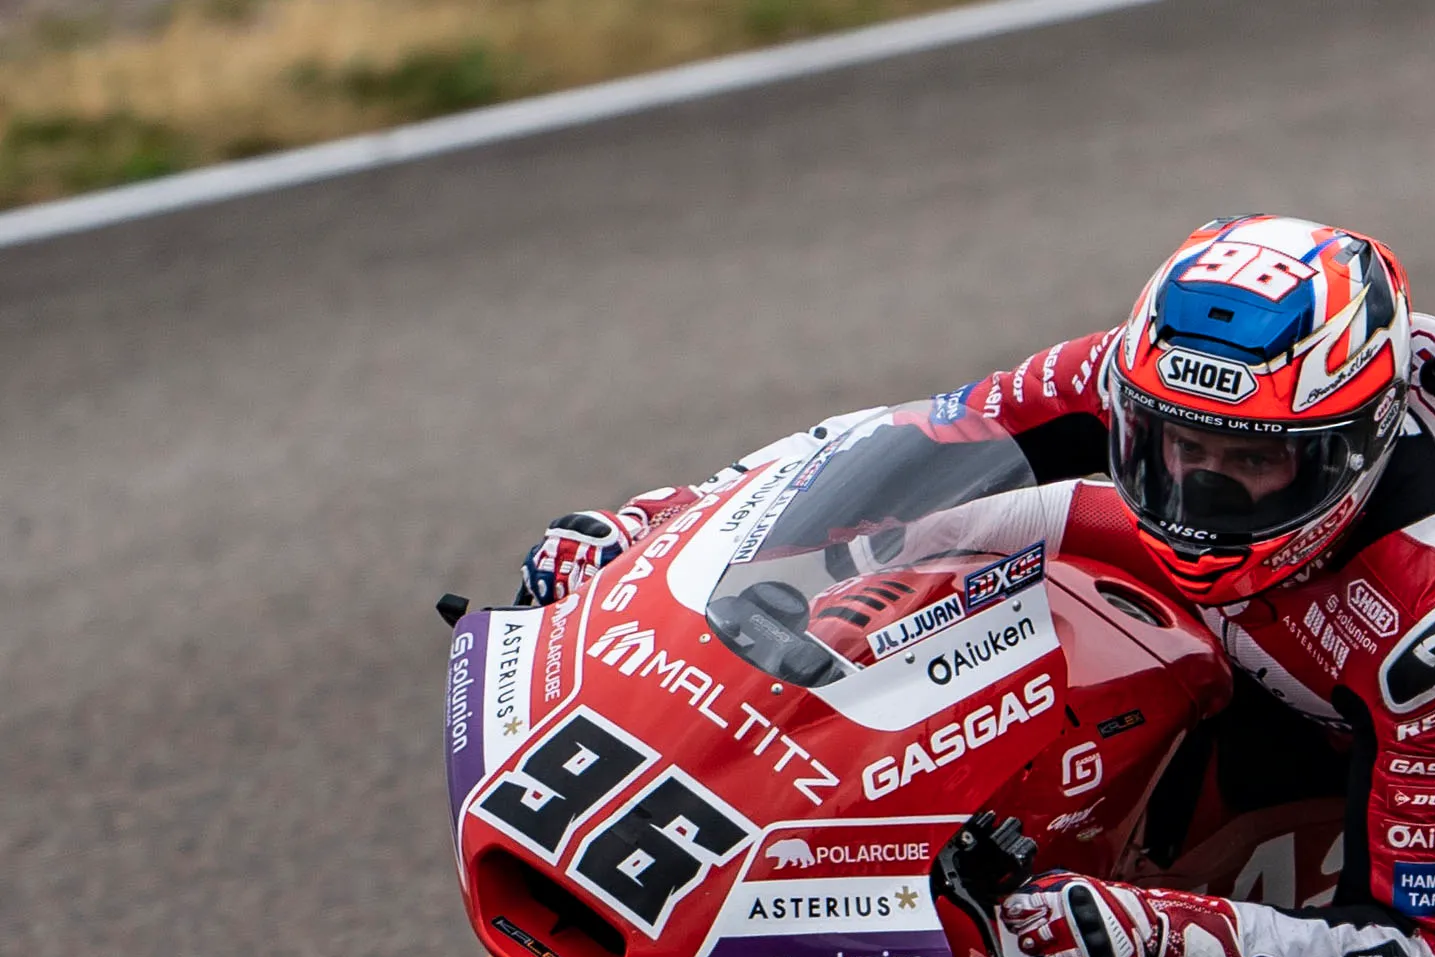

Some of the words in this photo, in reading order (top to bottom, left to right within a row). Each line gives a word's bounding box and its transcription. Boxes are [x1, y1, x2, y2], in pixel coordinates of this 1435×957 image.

[1179, 241, 1319, 303] 96
[1167, 356, 1242, 396] SHOEI
[1122, 385, 1156, 408] TRADE
[1159, 402, 1223, 427] WATCHES
[1228, 420, 1249, 430] UK
[1254, 421, 1283, 433] LTD
[1168, 522, 1209, 541] NSC
[900, 598, 962, 643] J.JUAN
[1335, 609, 1379, 655] solunion
[1350, 585, 1394, 633] SHOEI
[496, 622, 524, 718] ASTERIUS
[544, 619, 569, 702] POLARCUBE
[954, 616, 1036, 677] Aiuken
[1282, 615, 1330, 673] ASTERIUS
[452, 656, 475, 752] solunion
[640, 650, 841, 807] MALTITZ
[861, 672, 1056, 801] GASGAS
[470, 706, 762, 938] 96
[816, 842, 930, 864] POLARCUBE
[748, 896, 892, 920] ASTERIUS
